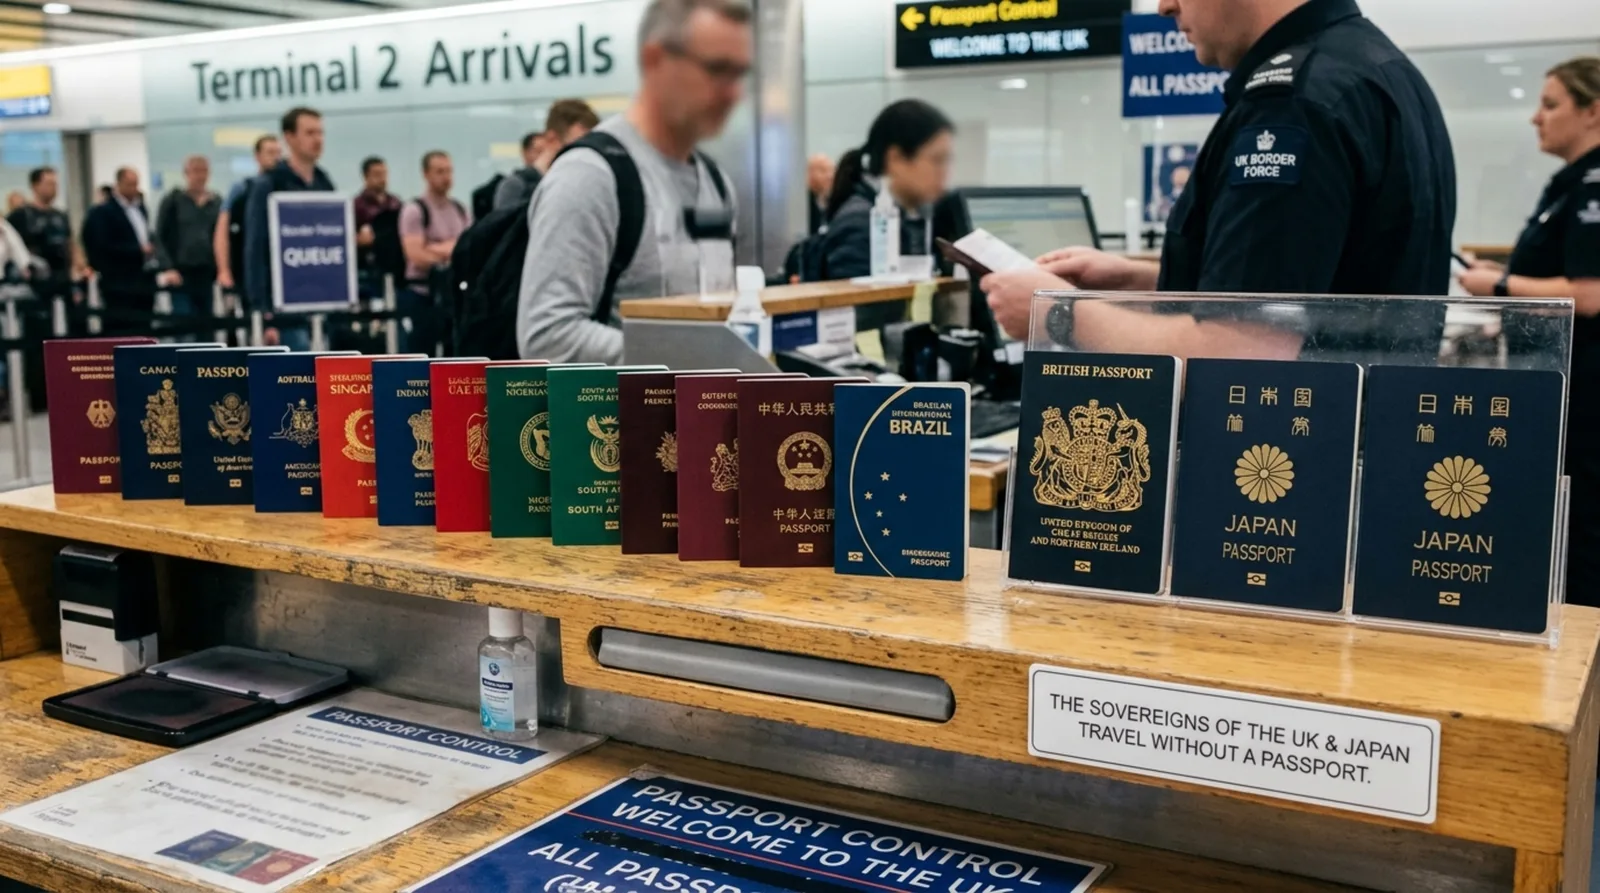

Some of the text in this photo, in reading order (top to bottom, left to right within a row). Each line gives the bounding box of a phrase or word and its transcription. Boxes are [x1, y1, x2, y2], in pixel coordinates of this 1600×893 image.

[929, 28, 1089, 59] WELCOME TO THE UK
[192, 23, 614, 103] Terminal 2 Arrivals
[1129, 75, 1162, 98] ALL
[1234, 152, 1297, 168] UK BORDER
[1243, 165, 1281, 179] FORCE
[283, 246, 345, 268] QUEUE
[1042, 364, 1153, 380] BRITISH PASSPORT
[889, 419, 952, 436] BRAZIL
[577, 486, 608, 494] SOUTH
[568, 505, 603, 514] SOUTH
[779, 523, 830, 533] PASSPORT
[1224, 514, 1297, 537] JAPAN
[1029, 536, 1049, 546] AND
[1413, 530, 1494, 555] JAPAN
[1222, 542, 1296, 565] PASSPORT
[1411, 559, 1493, 584] PASSPORT
[325, 709, 428, 738] PASSPORT
[427, 731, 522, 760] CONTROL
[1050, 692, 1411, 764] THE SOVEREIGNS OF THE UK & JAPAN
[1078, 720, 1372, 784] TRAVEL WITHOUT A PASSPORT.
[632, 784, 1042, 886] PASSPORT CONTROL
[528, 842, 601, 871] ALL
[611, 801, 1015, 893] WELCOME TO THE UK
